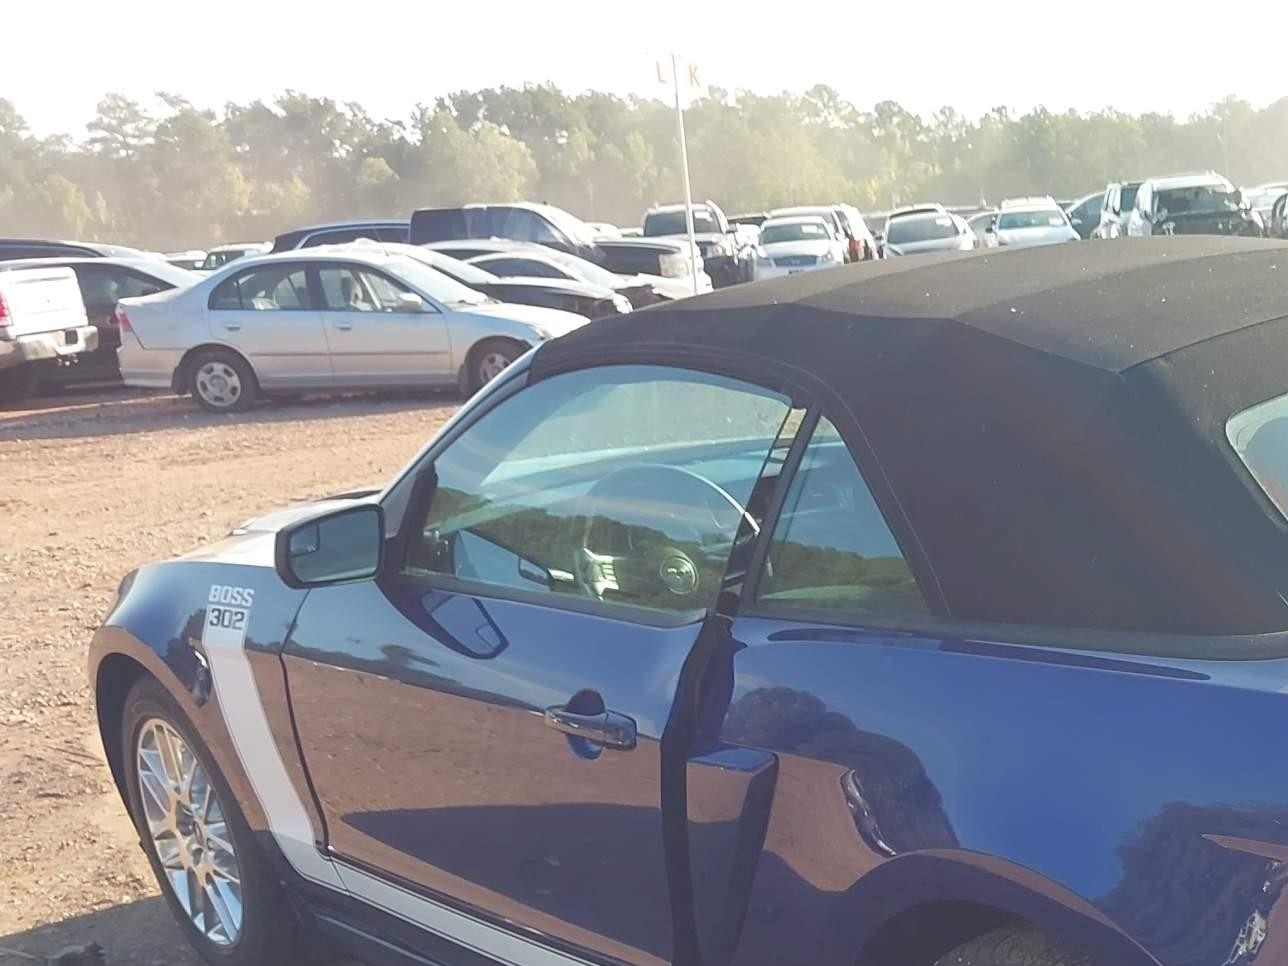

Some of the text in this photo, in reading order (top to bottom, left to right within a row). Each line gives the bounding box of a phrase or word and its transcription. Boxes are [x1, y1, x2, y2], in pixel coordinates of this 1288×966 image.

[689, 63, 701, 87] K
[208, 584, 255, 608] BOSS
[209, 607, 246, 631] 302
